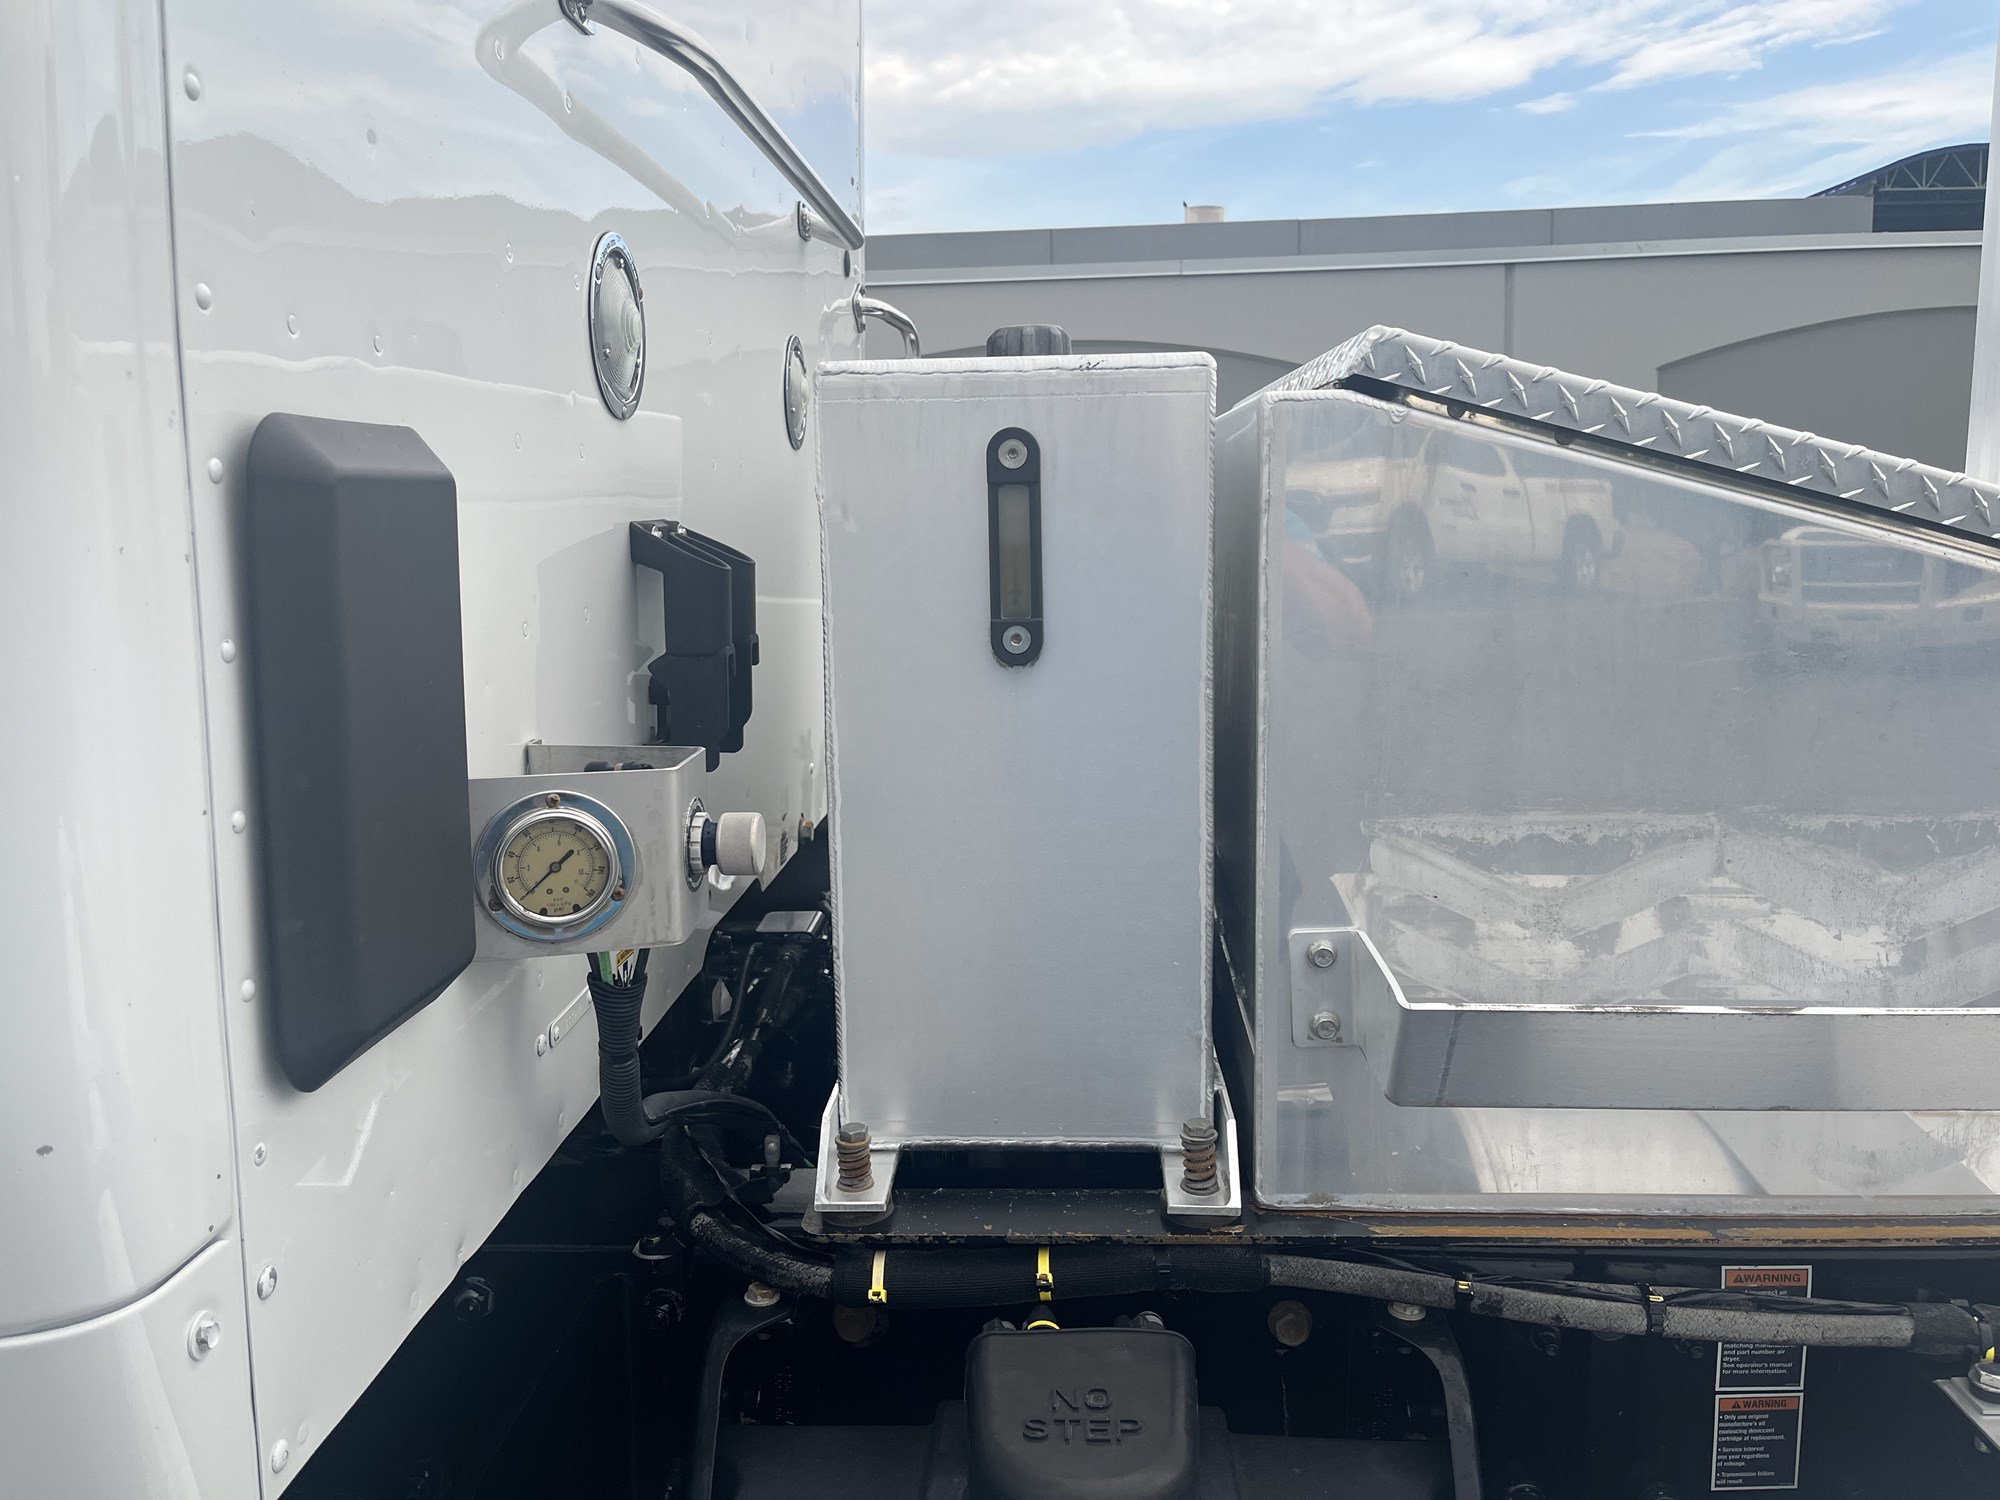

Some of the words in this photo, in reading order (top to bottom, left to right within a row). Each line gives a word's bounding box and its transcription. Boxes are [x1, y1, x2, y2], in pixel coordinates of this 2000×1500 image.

[598, 866, 606, 875] 140
[1744, 1274, 1801, 1283] WARNING
[1050, 1386, 1112, 1414] NO
[1743, 1400, 1786, 1408] WARNING
[1022, 1417, 1144, 1445] STEP
